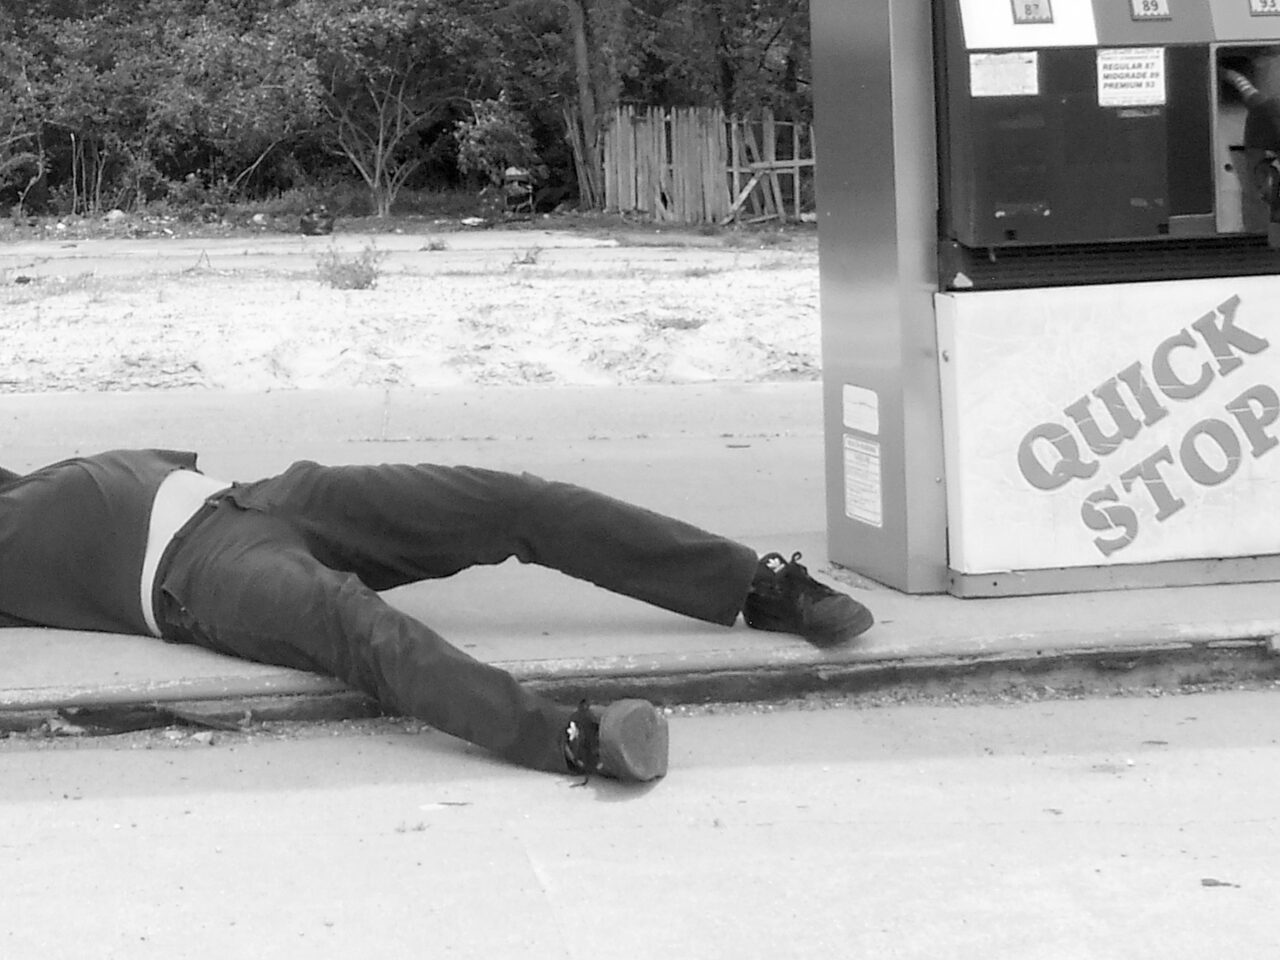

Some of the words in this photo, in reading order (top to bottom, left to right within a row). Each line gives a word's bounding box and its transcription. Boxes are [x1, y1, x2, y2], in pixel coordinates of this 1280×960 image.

[1024, 3, 1039, 16] 87
[1142, 0, 1159, 12] 89
[1103, 63, 1142, 71] REGULAR
[1103, 81, 1143, 89] PREMIUM
[1018, 294, 1270, 491] QUICK
[1081, 384, 1280, 557] STOP
